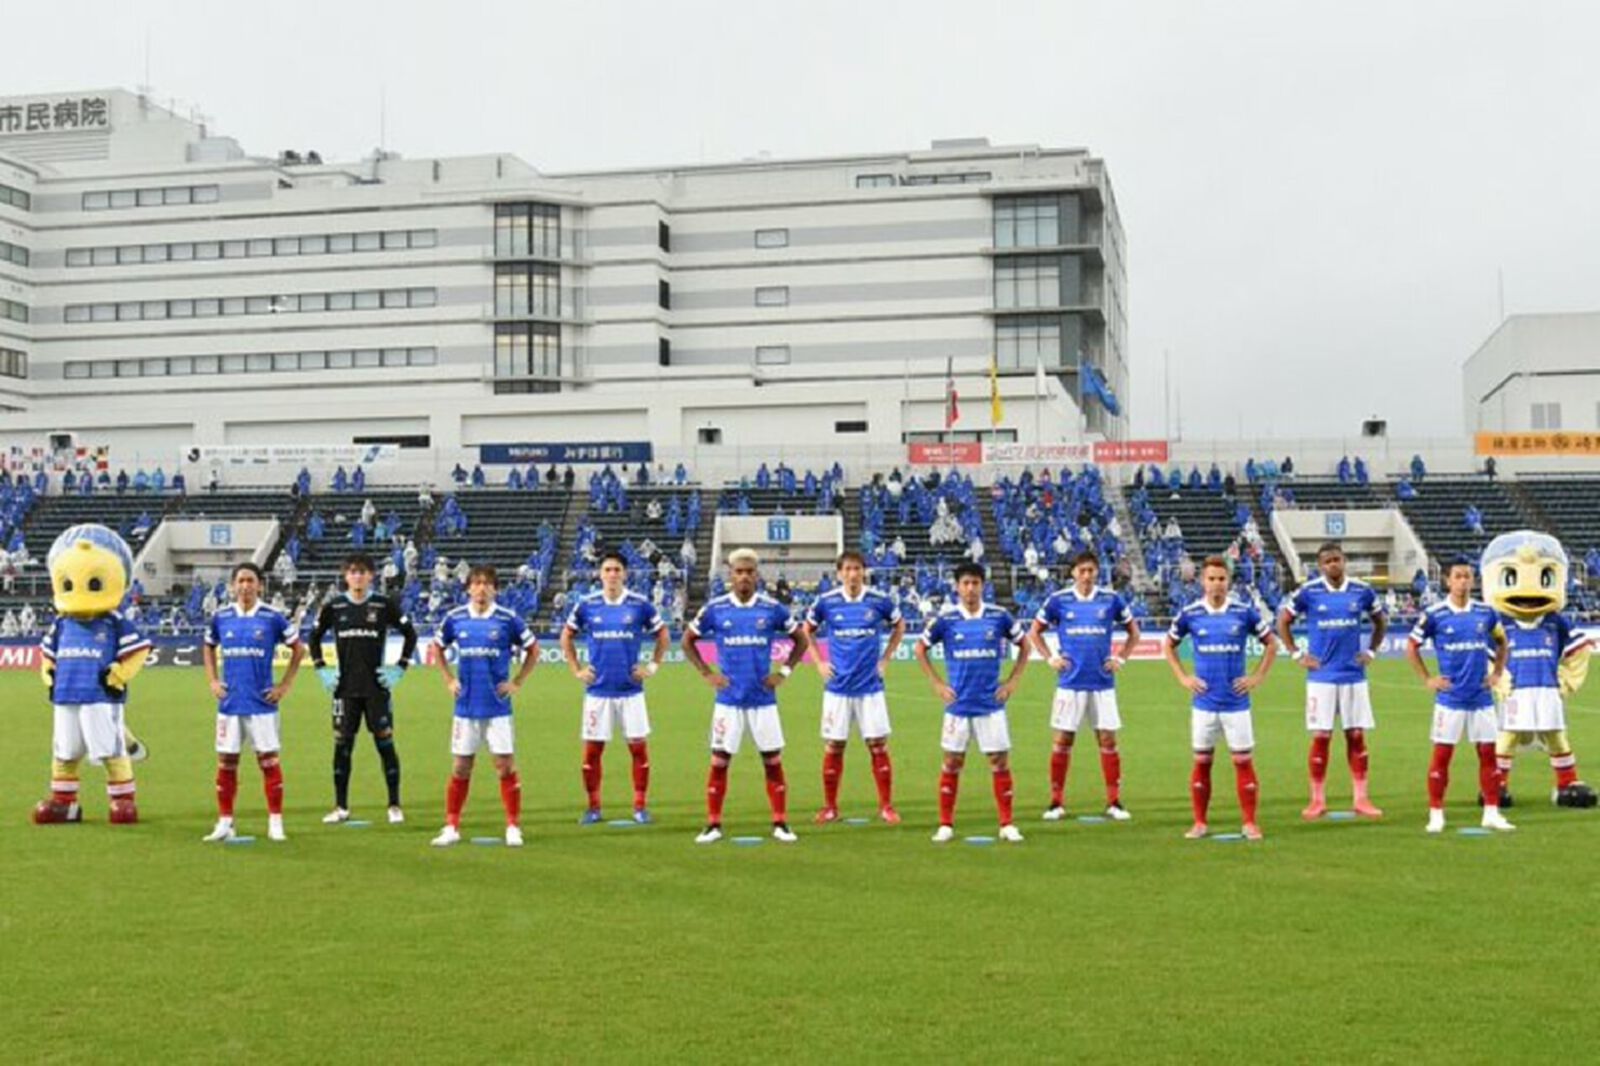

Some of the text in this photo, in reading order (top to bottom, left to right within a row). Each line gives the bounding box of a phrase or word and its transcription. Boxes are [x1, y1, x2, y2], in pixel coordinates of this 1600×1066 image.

[0, 97, 107, 131] 市民病院
[774, 527, 785, 540] 11
